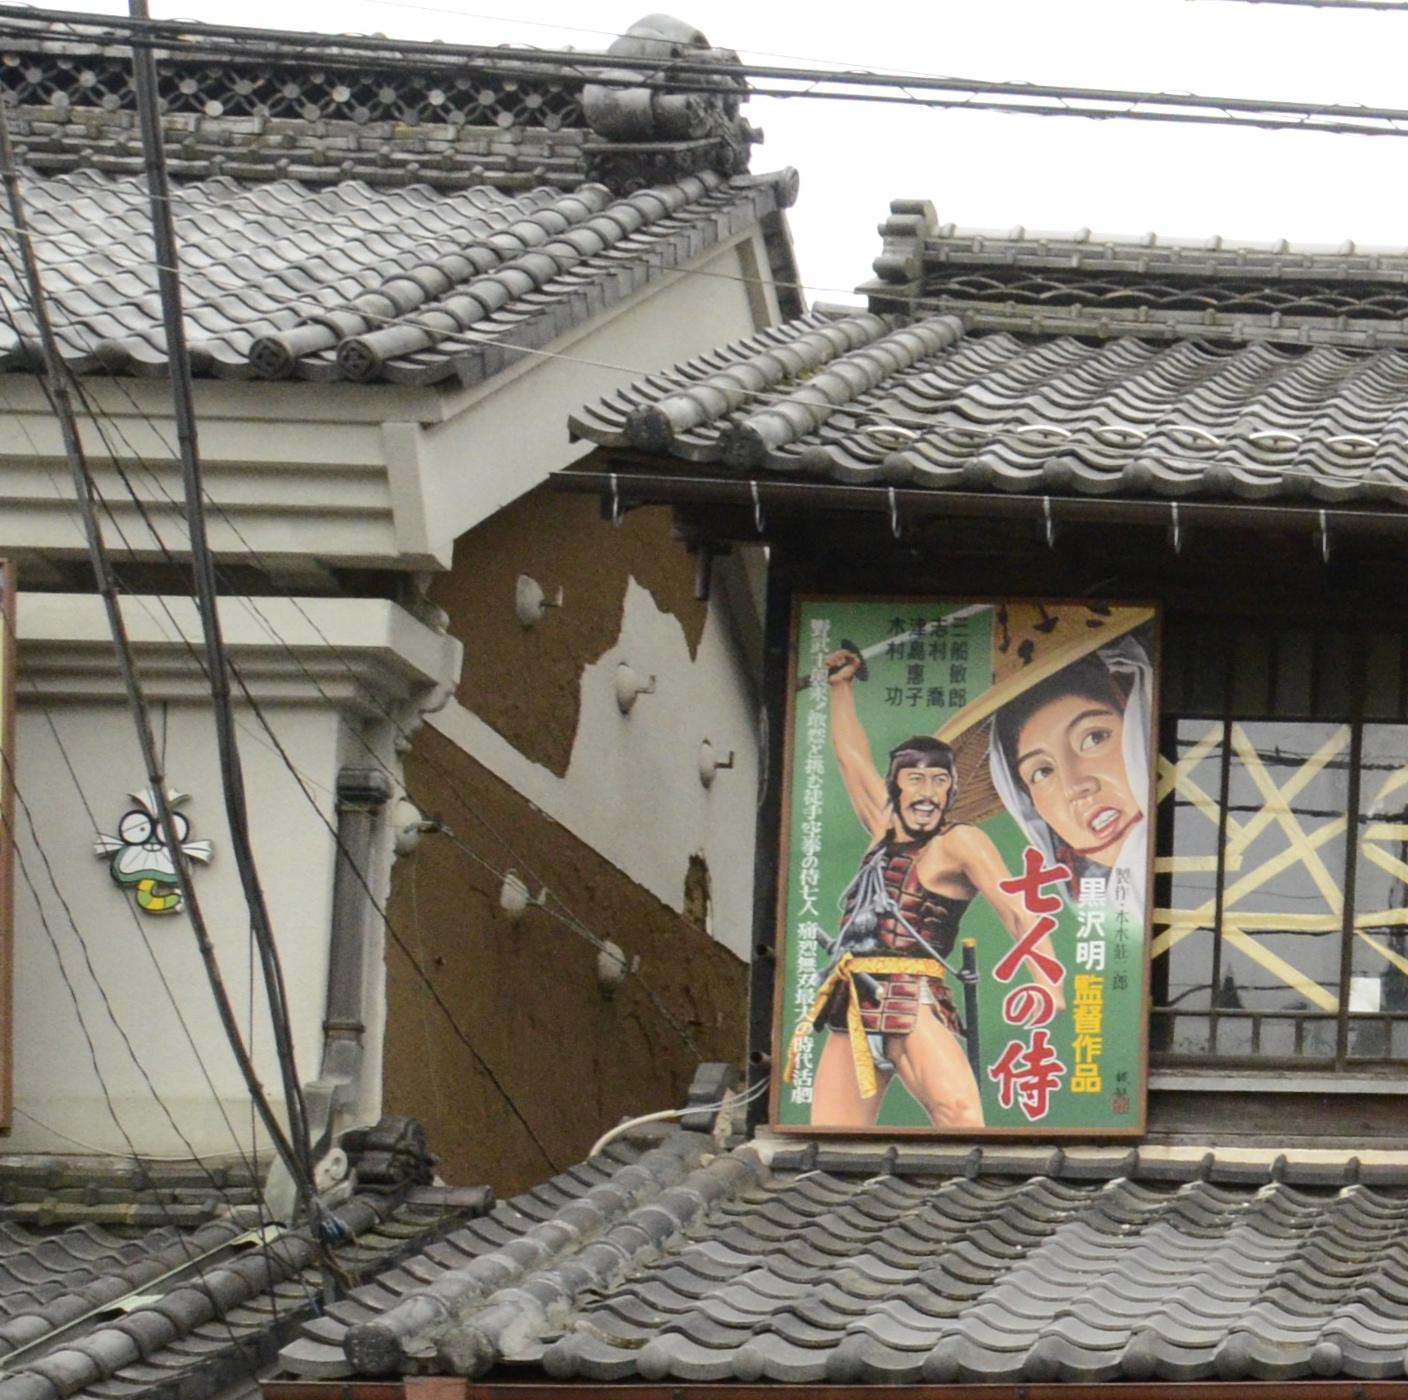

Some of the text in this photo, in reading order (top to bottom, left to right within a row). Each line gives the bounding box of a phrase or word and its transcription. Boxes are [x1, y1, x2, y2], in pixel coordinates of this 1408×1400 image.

[949, 617, 969, 707] 三船敏郎
[988, 847, 1072, 1120] 七人の侍
